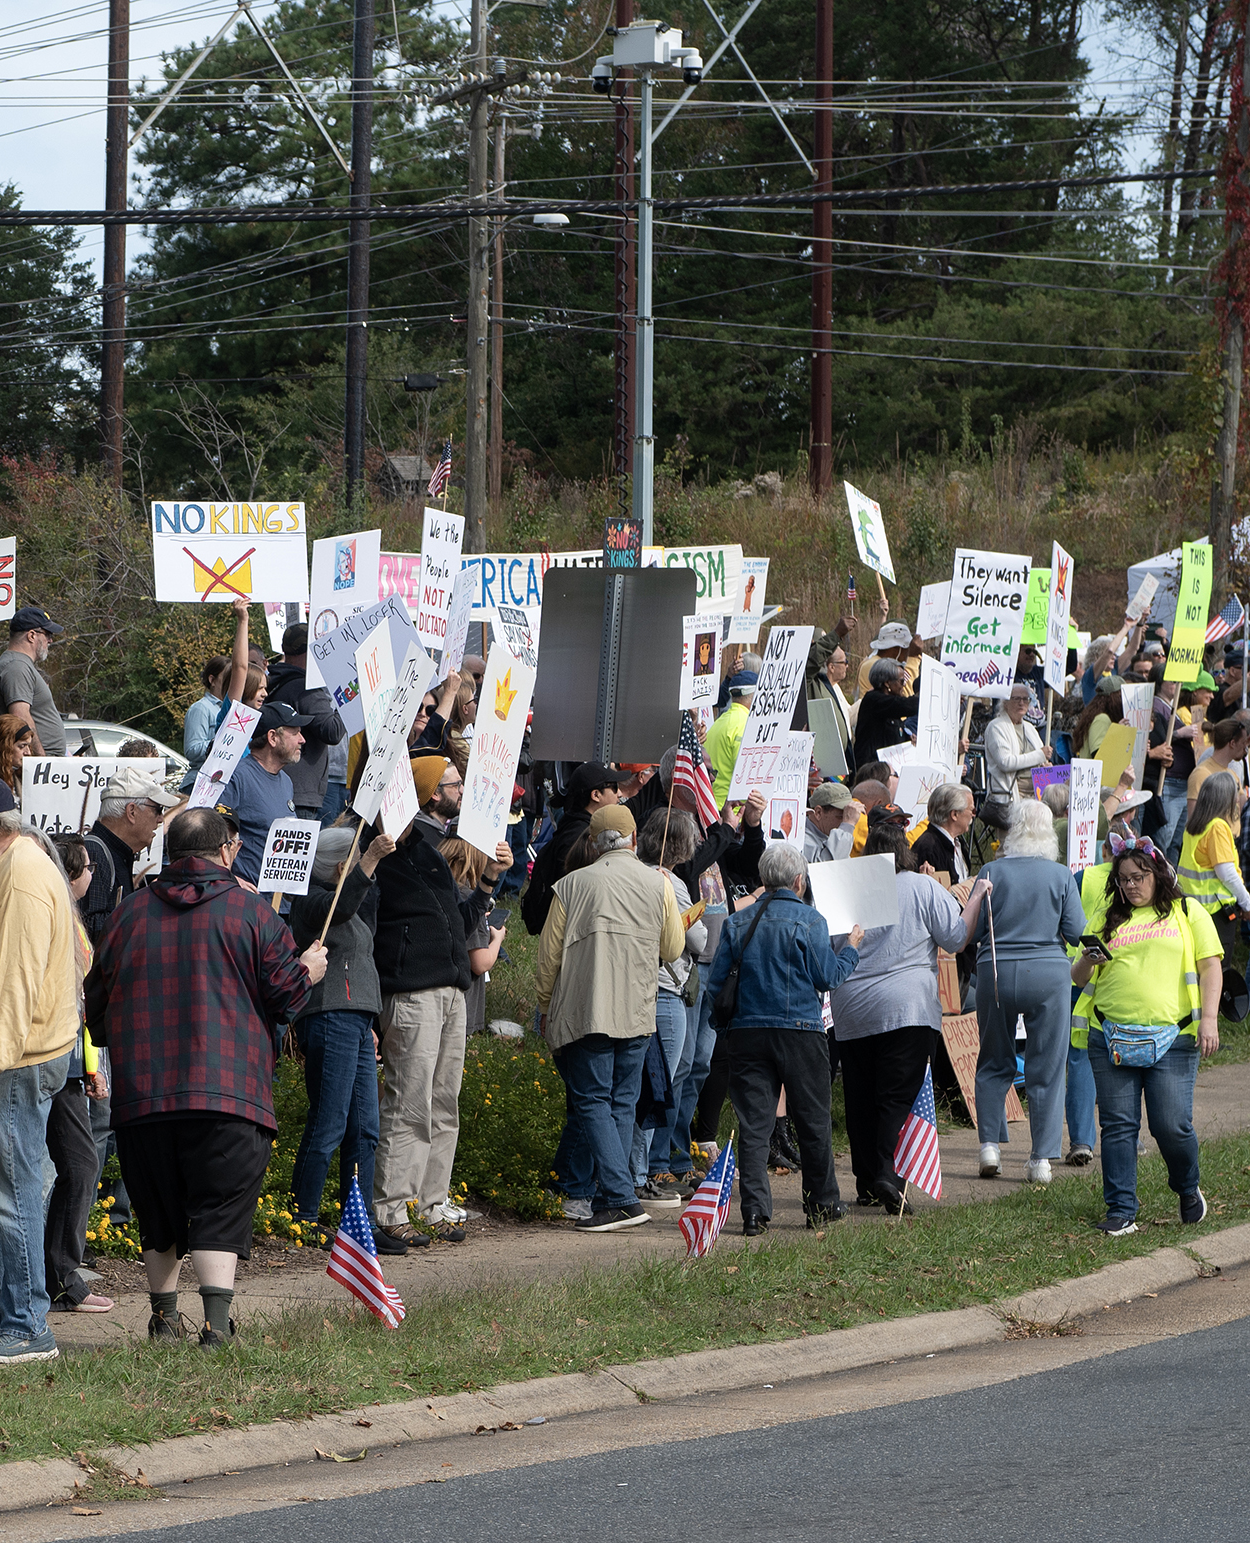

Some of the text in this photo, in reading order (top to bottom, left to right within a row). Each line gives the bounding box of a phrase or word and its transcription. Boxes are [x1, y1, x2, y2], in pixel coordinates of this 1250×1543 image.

[155, 503, 299, 534] NO KINGS
[430, 518, 440, 539] We
[616, 532, 628, 549] NO
[1190, 548, 1206, 566] THIS
[425, 555, 449, 584] People
[959, 556, 1031, 587] They want
[334, 579, 354, 591] NOPE
[379, 556, 421, 607] OVE
[1192, 578, 1199, 594] IS
[423, 585, 444, 609] NOT
[962, 585, 1022, 611] Silence
[1185, 605, 1202, 621] NOT
[313, 637, 336, 660] GET
[361, 598, 410, 631] LOSER
[419, 612, 447, 637] DICTATO
[967, 617, 1001, 638] Get
[766, 630, 796, 661] NOT
[945, 635, 1013, 656] informed
[1169, 647, 1203, 665] NORMAL!
[758, 660, 803, 692] USUALLY
[944, 661, 983, 684] pea
[929, 668, 959, 729] FUC
[222, 733, 234, 747] NO
[755, 722, 779, 743] BUT
[491, 733, 514, 778] KINGS
[735, 745, 781, 786] JEEZ
[33, 762, 69, 789] Hey
[483, 759, 504, 785] SINCE
[1034, 773, 1051, 787] ASS
[472, 775, 505, 828] 1776
[274, 829, 312, 841] HANDS
[1075, 820, 1095, 836] WON'T
[272, 841, 310, 857] OFF!
[1079, 839, 1088, 859] BE
[266, 858, 308, 871] VETERAN
[263, 869, 306, 882] SERVICES
[1118, 919, 1169, 936] KINDNESS
[1107, 927, 1179, 951] COORDINATOR
